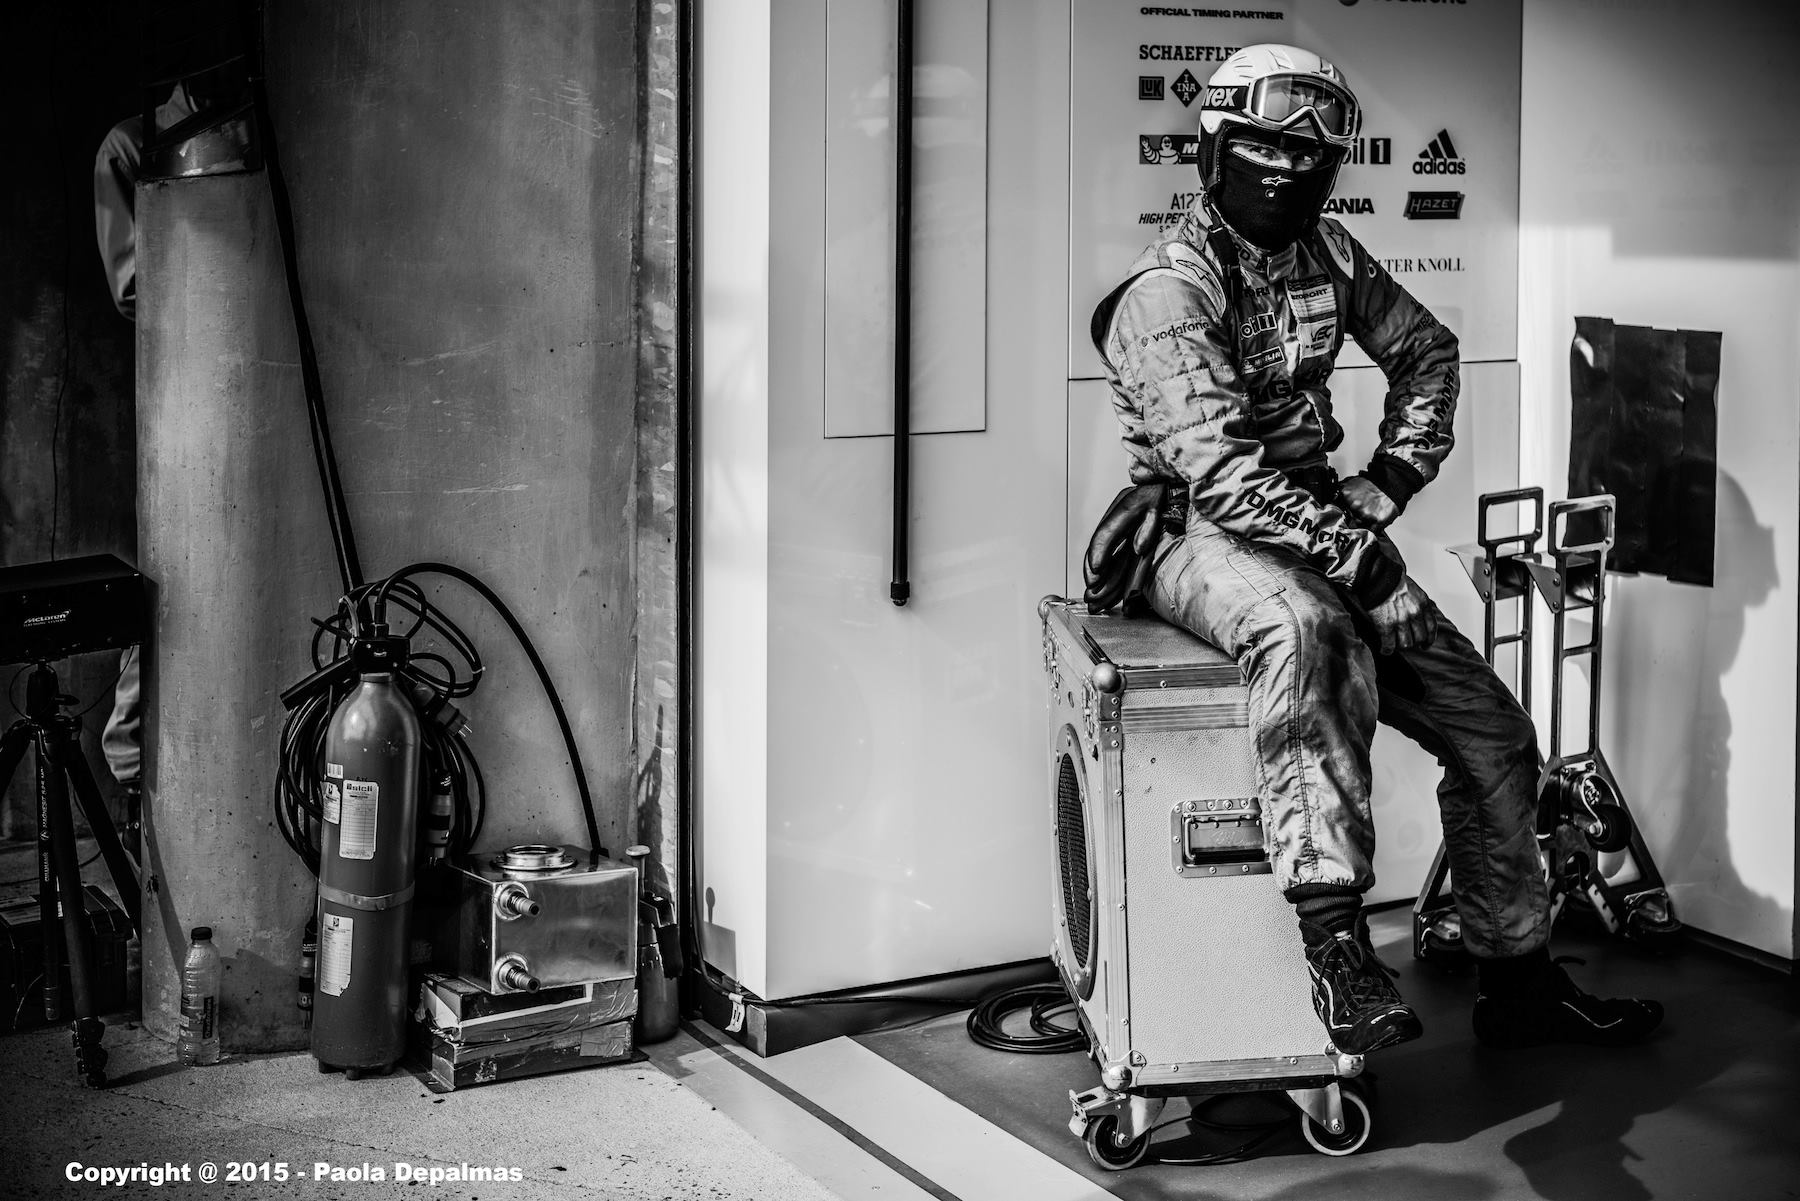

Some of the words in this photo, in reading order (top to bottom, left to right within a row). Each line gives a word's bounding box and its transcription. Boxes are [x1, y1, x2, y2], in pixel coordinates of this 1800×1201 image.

[1140, 7, 1191, 17] OFFICIAL
[1192, 8, 1231, 18] TIMING
[1232, 10, 1284, 20] PARTNER
[1139, 44, 1242, 62] SCHAEFFLE
[1182, 142, 1199, 154] M
[1412, 159, 1466, 175] adidas
[1170, 192, 1202, 210] A12
[1321, 198, 1375, 214] ANIA
[1410, 198, 1458, 213] HAZET
[1138, 212, 1164, 224] HIGH
[1378, 258, 1413, 272] TER
[1417, 257, 1465, 272] KNOLL
[1246, 489, 1300, 529] DMG
[24, 613, 66, 624] McLaren
